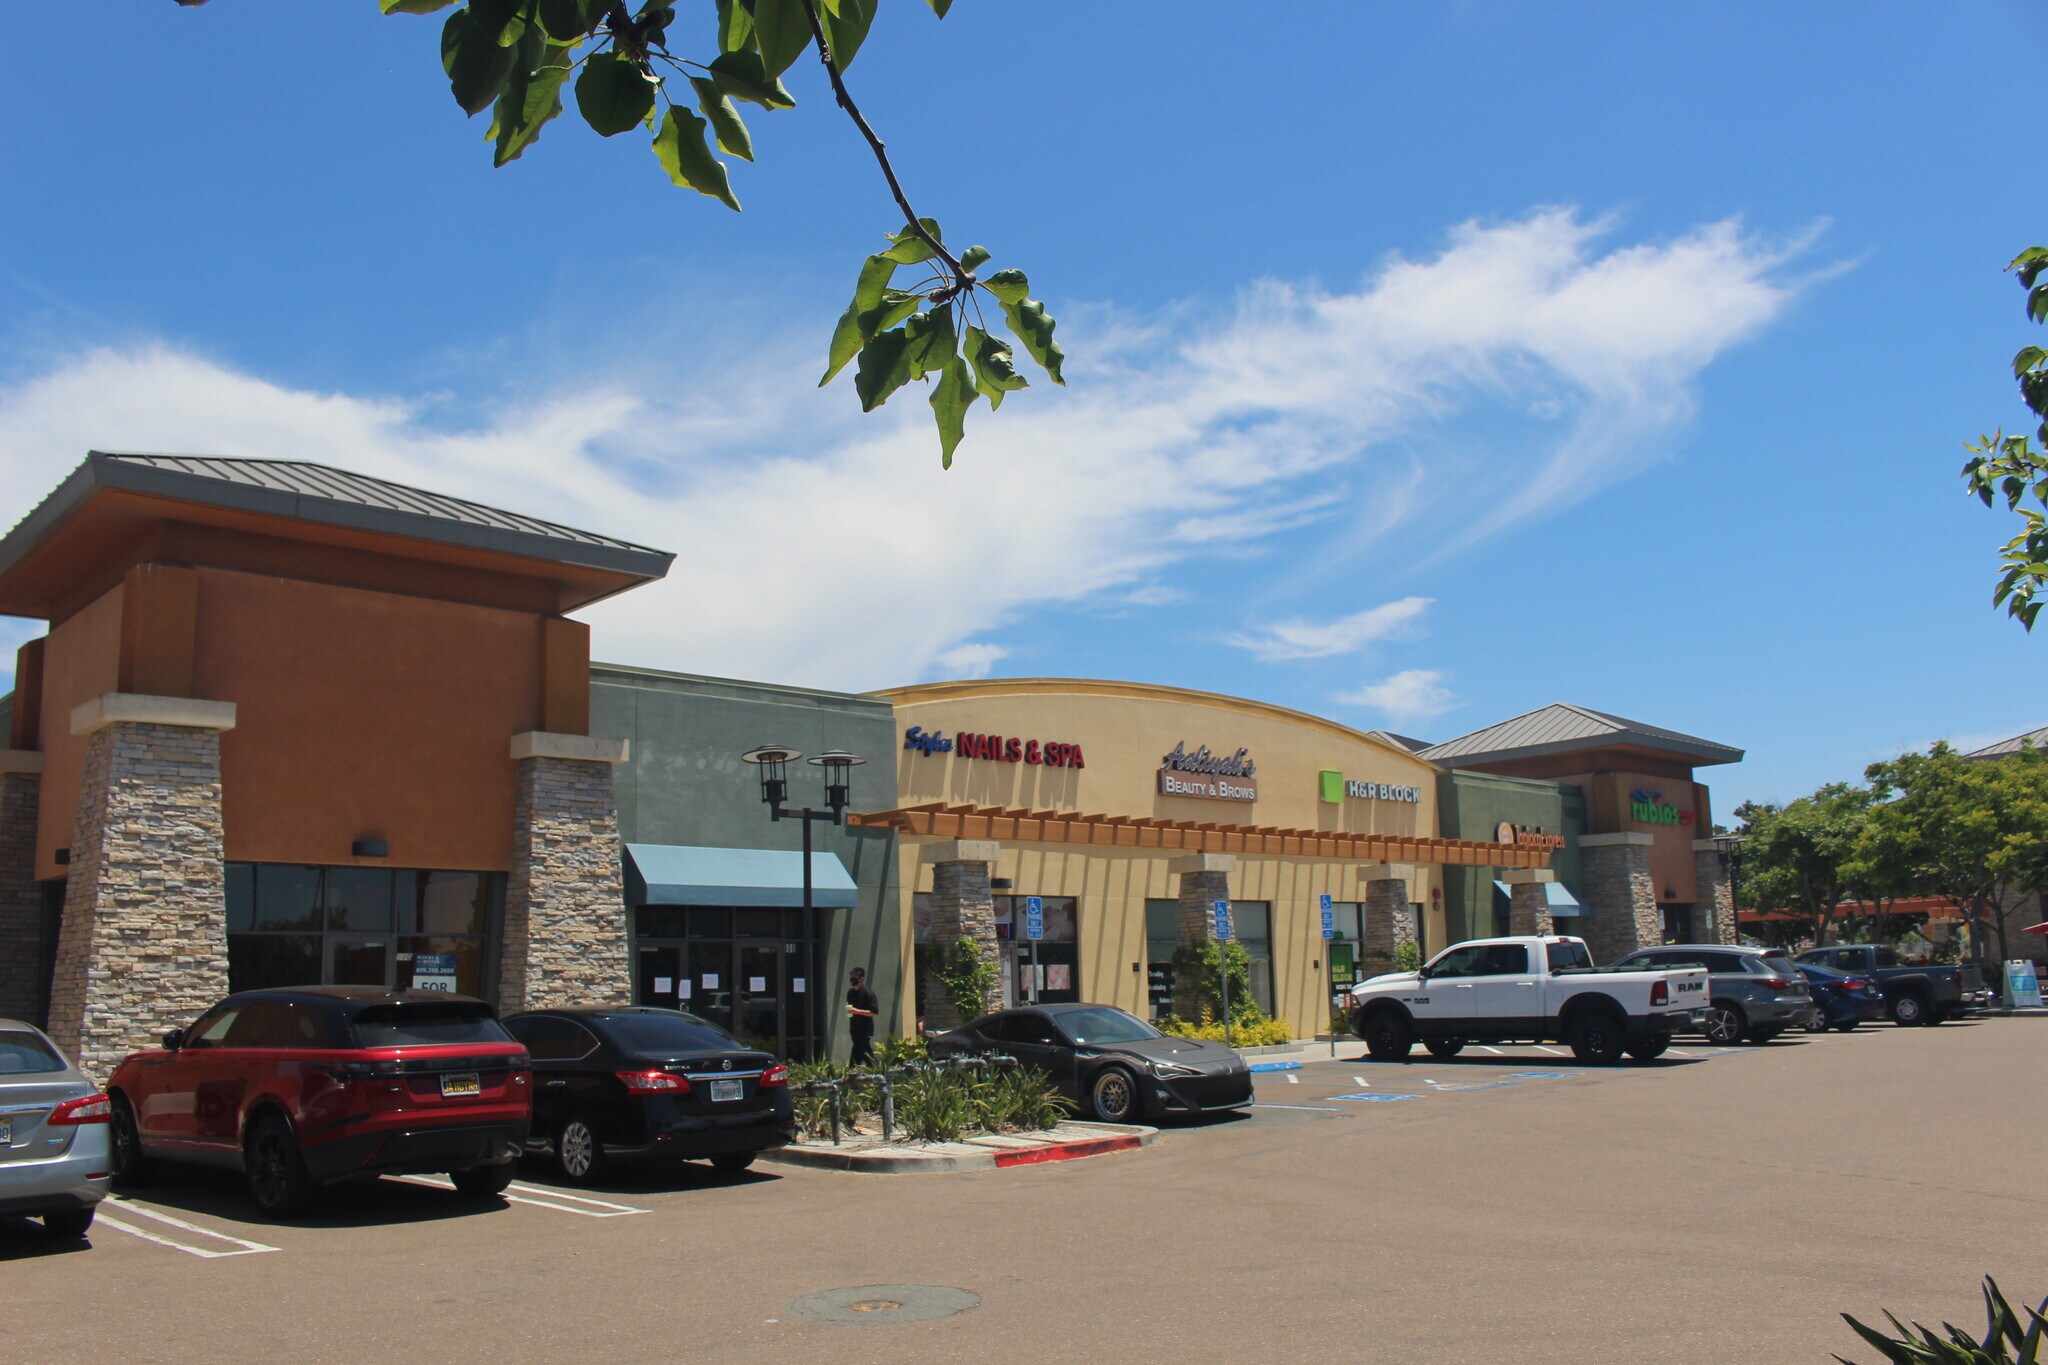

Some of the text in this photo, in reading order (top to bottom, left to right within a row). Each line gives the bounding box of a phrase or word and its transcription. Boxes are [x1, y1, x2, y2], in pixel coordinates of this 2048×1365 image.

[957, 731, 1022, 763] NAILS
[1025, 739, 1043, 766] &
[1044, 742, 1085, 769] SPA
[1209, 784, 1217, 797] &
[1347, 781, 1421, 803] H&R BLOCK
[421, 982, 448, 992] FOR
[1678, 982, 1703, 992] RAM
